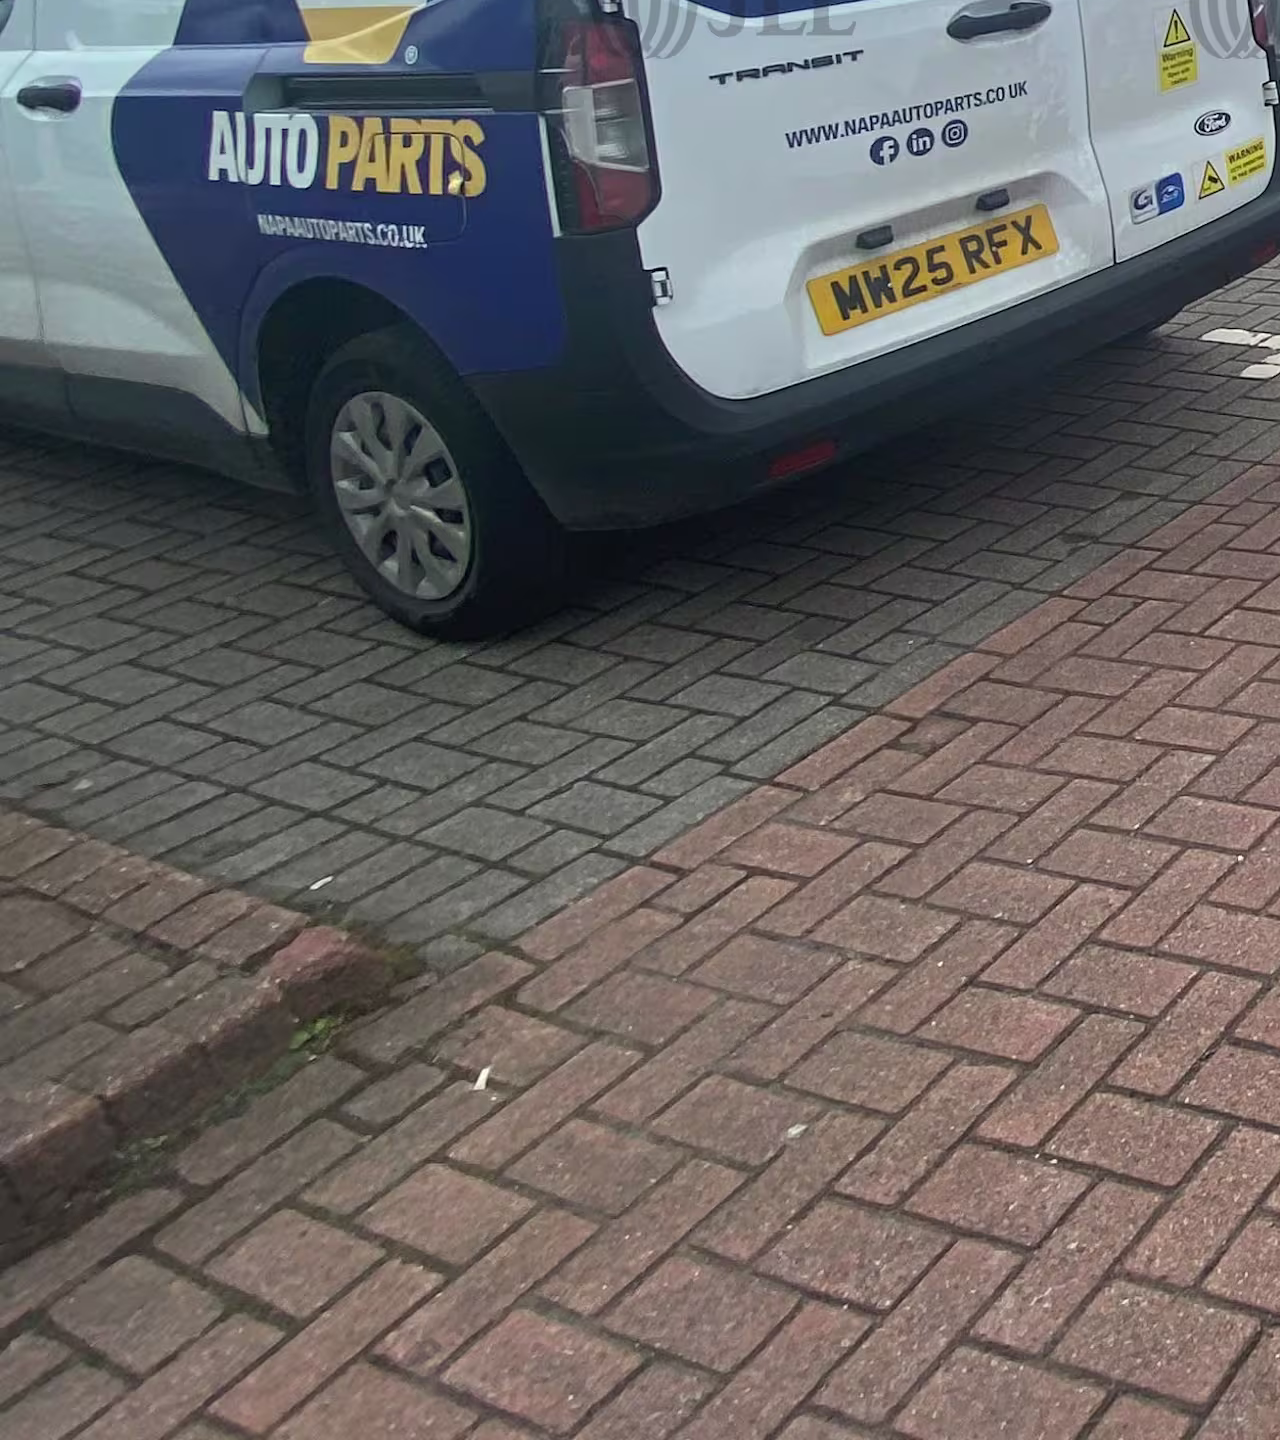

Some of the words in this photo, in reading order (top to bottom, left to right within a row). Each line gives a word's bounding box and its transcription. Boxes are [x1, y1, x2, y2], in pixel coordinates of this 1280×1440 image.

[708, 49, 865, 85] TRANSIT
[207, 110, 319, 189] AUTO
[325, 114, 486, 197] PARTS
[1228, 140, 1264, 165] WARNING
[257, 214, 428, 249] NAPAAUTOPARTS.CO.UK
[830, 244, 954, 321] MW25
[958, 214, 1043, 275] RFX
